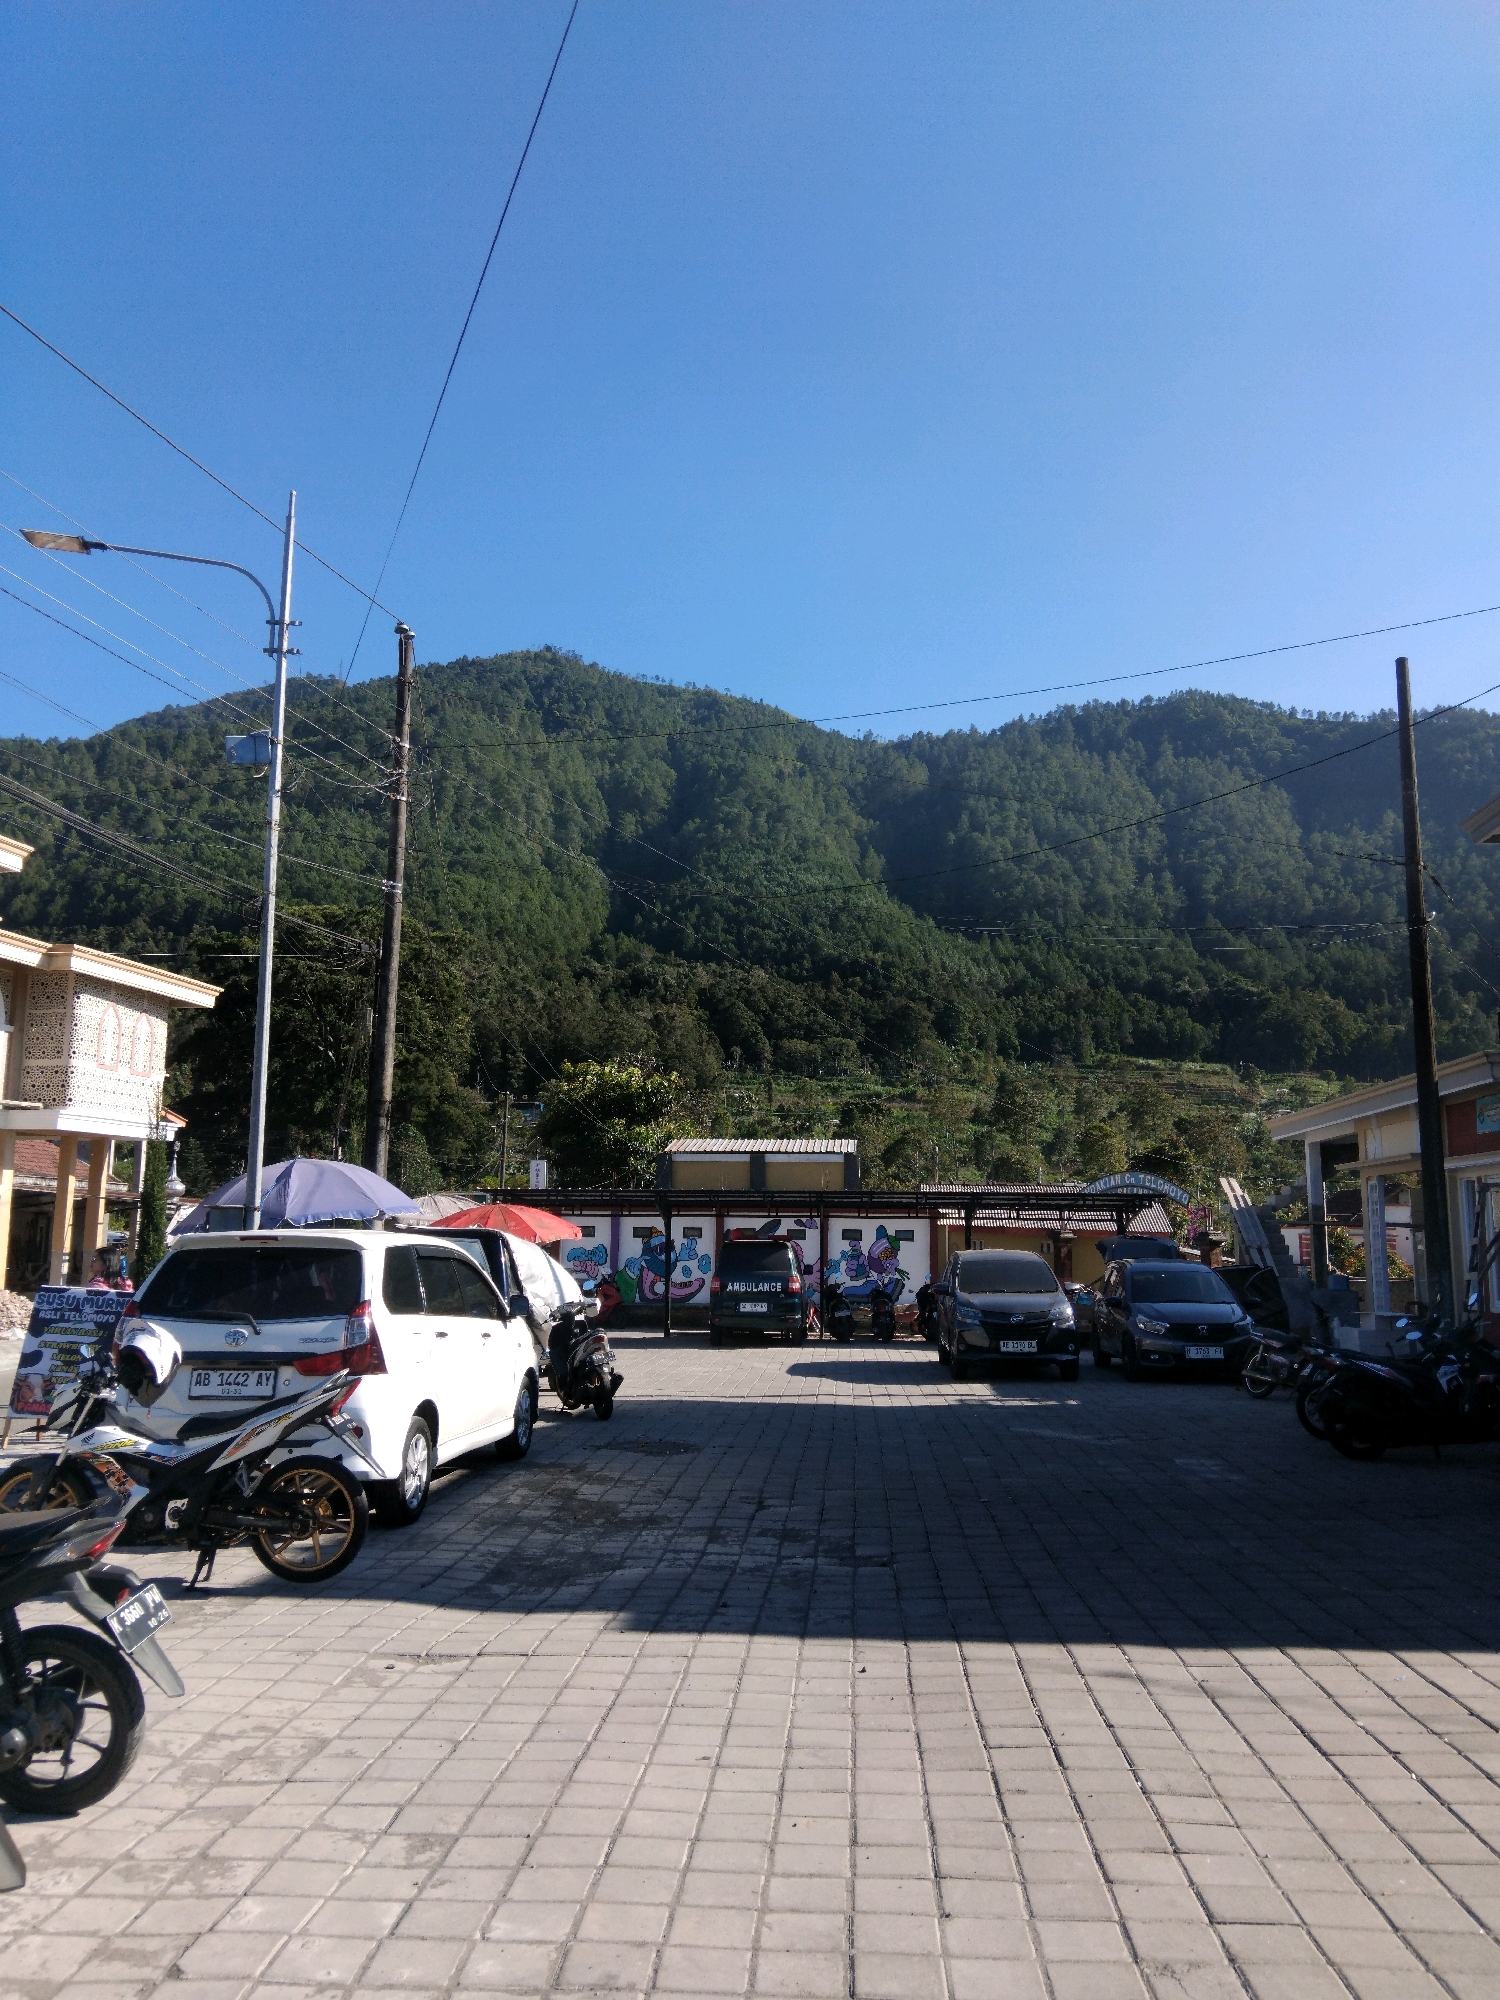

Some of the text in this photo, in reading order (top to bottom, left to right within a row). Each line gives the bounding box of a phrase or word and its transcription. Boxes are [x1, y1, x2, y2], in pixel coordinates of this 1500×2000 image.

[726, 1282, 782, 1292] AMBULANCE
[36, 1292, 77, 1309] SUSU
[38, 1311, 116, 1323] ASLI TELOMOYO
[52, 1353, 82, 1362] MELON
[194, 1372, 272, 1388] AB 1442 AY
[16, 1401, 53, 1414] PANAS
[110, 1616, 123, 1634] K
[120, 1601, 145, 1626] 3660
